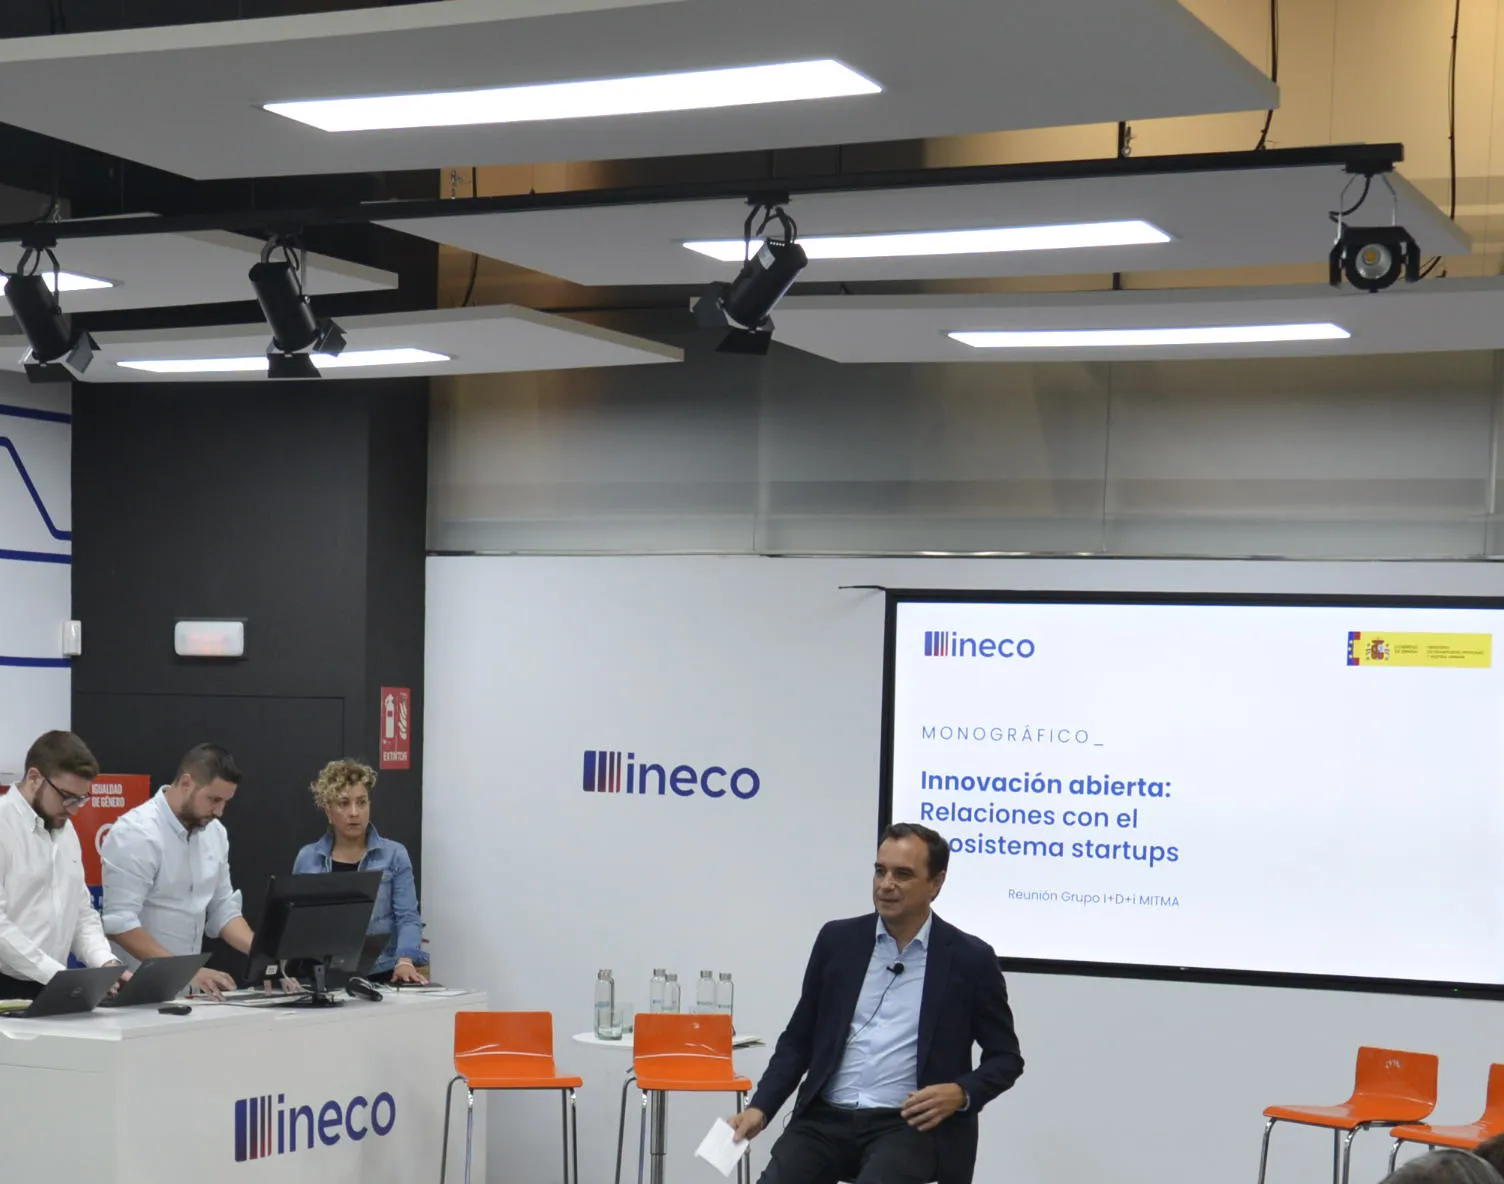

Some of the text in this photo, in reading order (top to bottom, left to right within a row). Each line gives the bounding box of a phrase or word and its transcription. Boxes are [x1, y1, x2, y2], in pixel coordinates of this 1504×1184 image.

[952, 631, 1035, 658] ineco
[91, 783, 123, 795] IGUALDAD
[626, 752, 760, 800] ineco
[920, 770, 1172, 798] Innovación abierta:
[91, 796, 126, 808] DE GÉNERO
[920, 802, 1138, 829] Relaciones con el
[949, 832, 1180, 868] osistema startups
[1008, 888, 1180, 907] Reunión Grupo I+D+i MITMA
[277, 1092, 396, 1155] ineco
